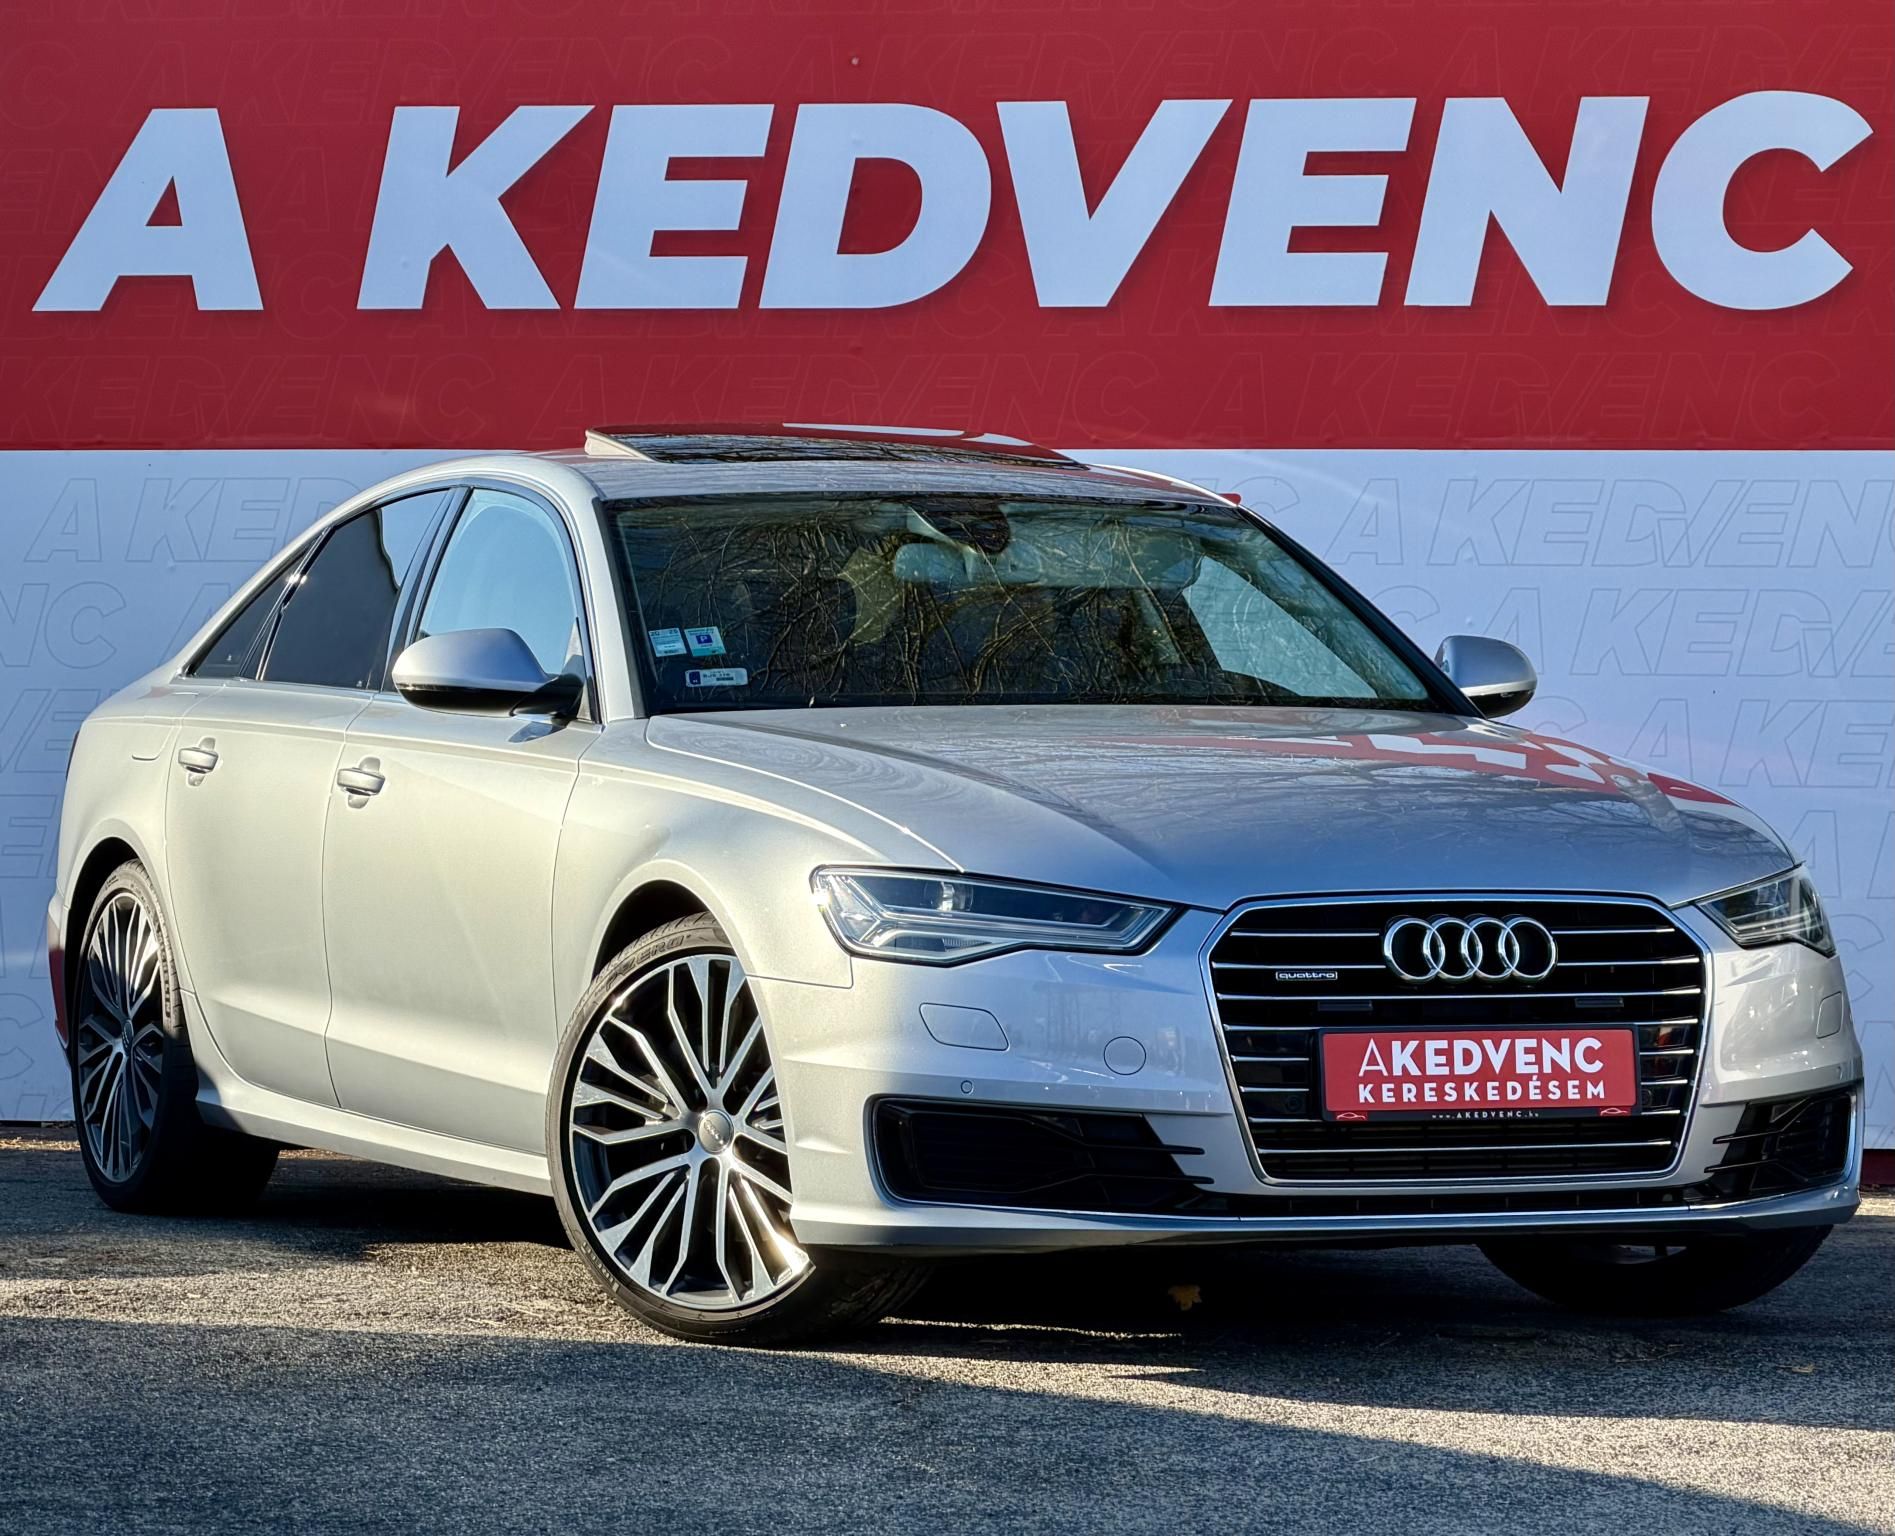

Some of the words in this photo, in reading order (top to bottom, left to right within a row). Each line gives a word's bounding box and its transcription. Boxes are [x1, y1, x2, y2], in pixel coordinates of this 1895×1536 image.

[31, 107, 265, 312] A
[356, 89, 1875, 312] KEDVENC
[23, 477, 102, 563] A
[1323, 477, 1406, 567] A
[1424, 478, 1895, 568] KEDVEN
[1358, 1075, 1605, 1103] KERESKEDÉSEM
